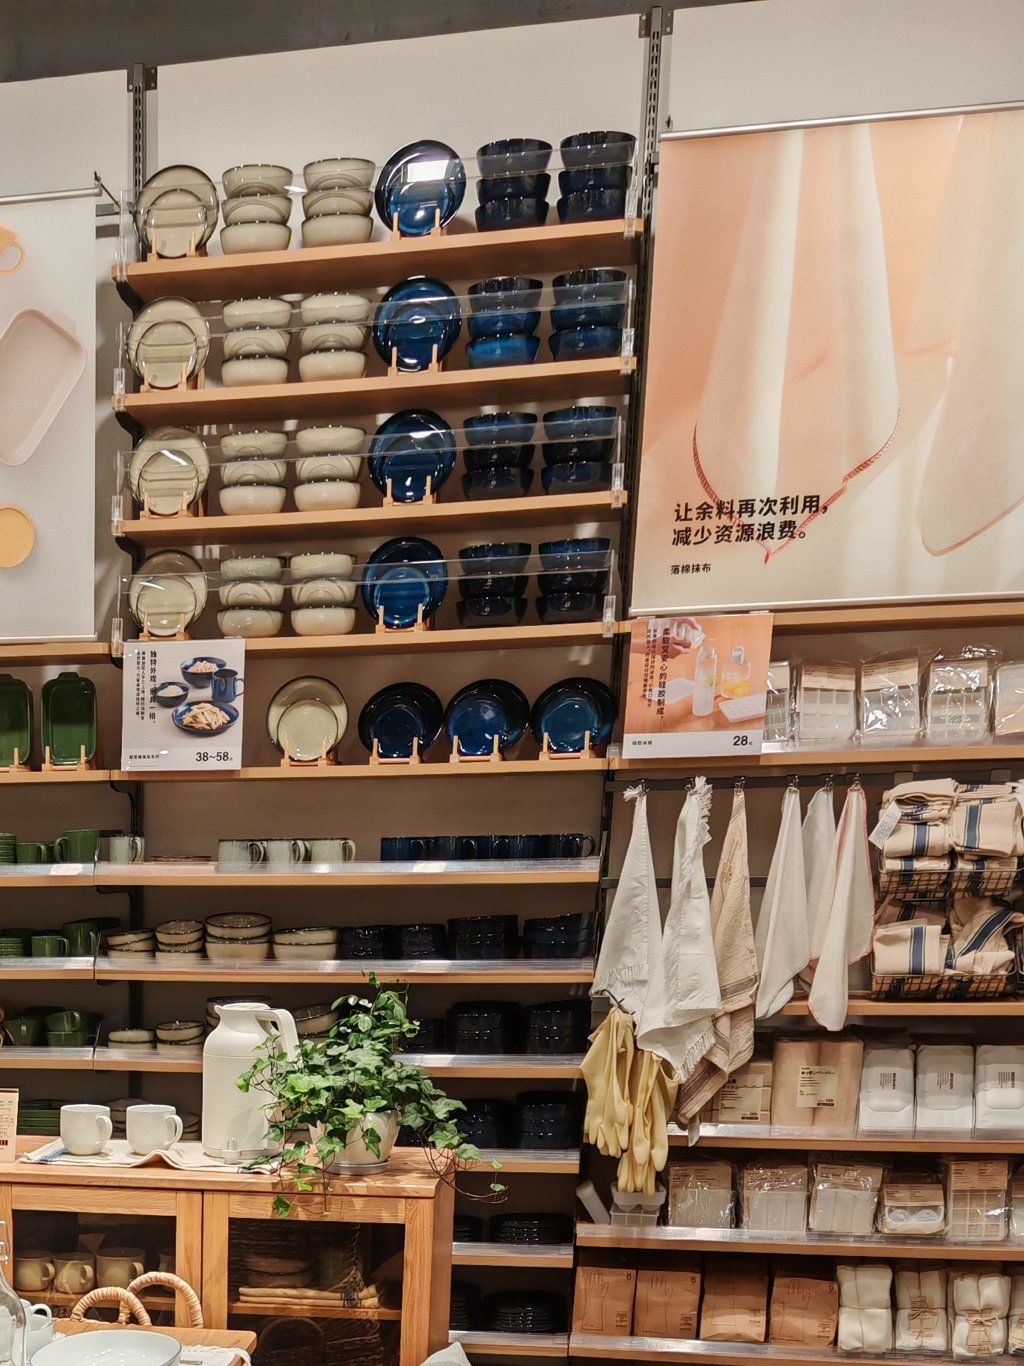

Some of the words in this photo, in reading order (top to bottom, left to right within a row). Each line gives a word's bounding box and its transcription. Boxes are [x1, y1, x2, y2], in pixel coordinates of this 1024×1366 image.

[675, 495, 828, 522] 让余料再次利用，
[672, 520, 805, 546] 减少资源浪费。
